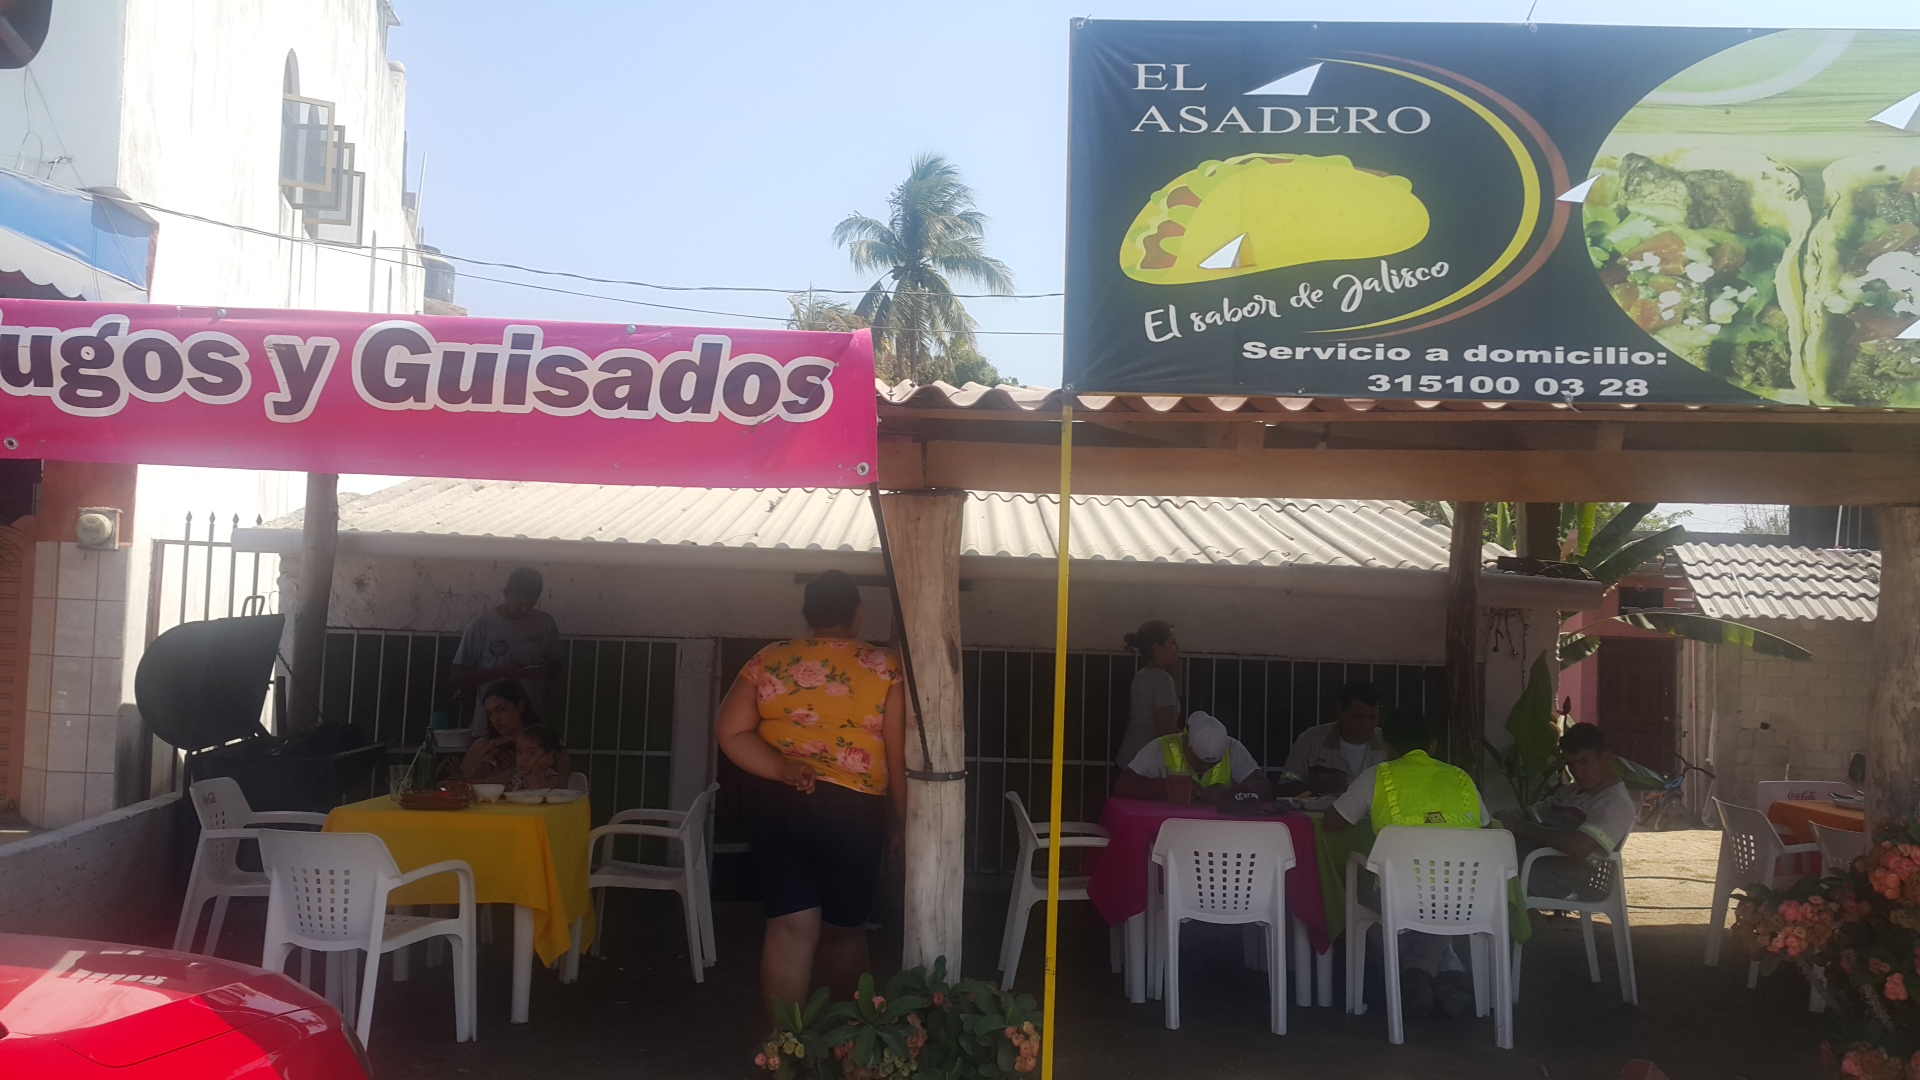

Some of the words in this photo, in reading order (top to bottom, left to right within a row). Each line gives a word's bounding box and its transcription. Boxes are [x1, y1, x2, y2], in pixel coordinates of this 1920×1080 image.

[1133, 64, 1207, 90] EL
[1131, 106, 1430, 133] ASADERO
[1143, 304, 1182, 342] El
[1189, 294, 1282, 333] sabor
[1290, 282, 1324, 310] de
[1332, 258, 1450, 312] Jalisco
[1243, 342, 1410, 360] Servicio
[1425, 347, 1449, 362] a
[1464, 344, 1670, 364] domicilio:
[0, 316, 249, 412] ugos
[265, 335, 335, 419] y
[354, 321, 836, 422] Guisados
[1368, 375, 1519, 393] 315100
[1534, 378, 1585, 396] 03
[1600, 379, 1648, 396] 28
